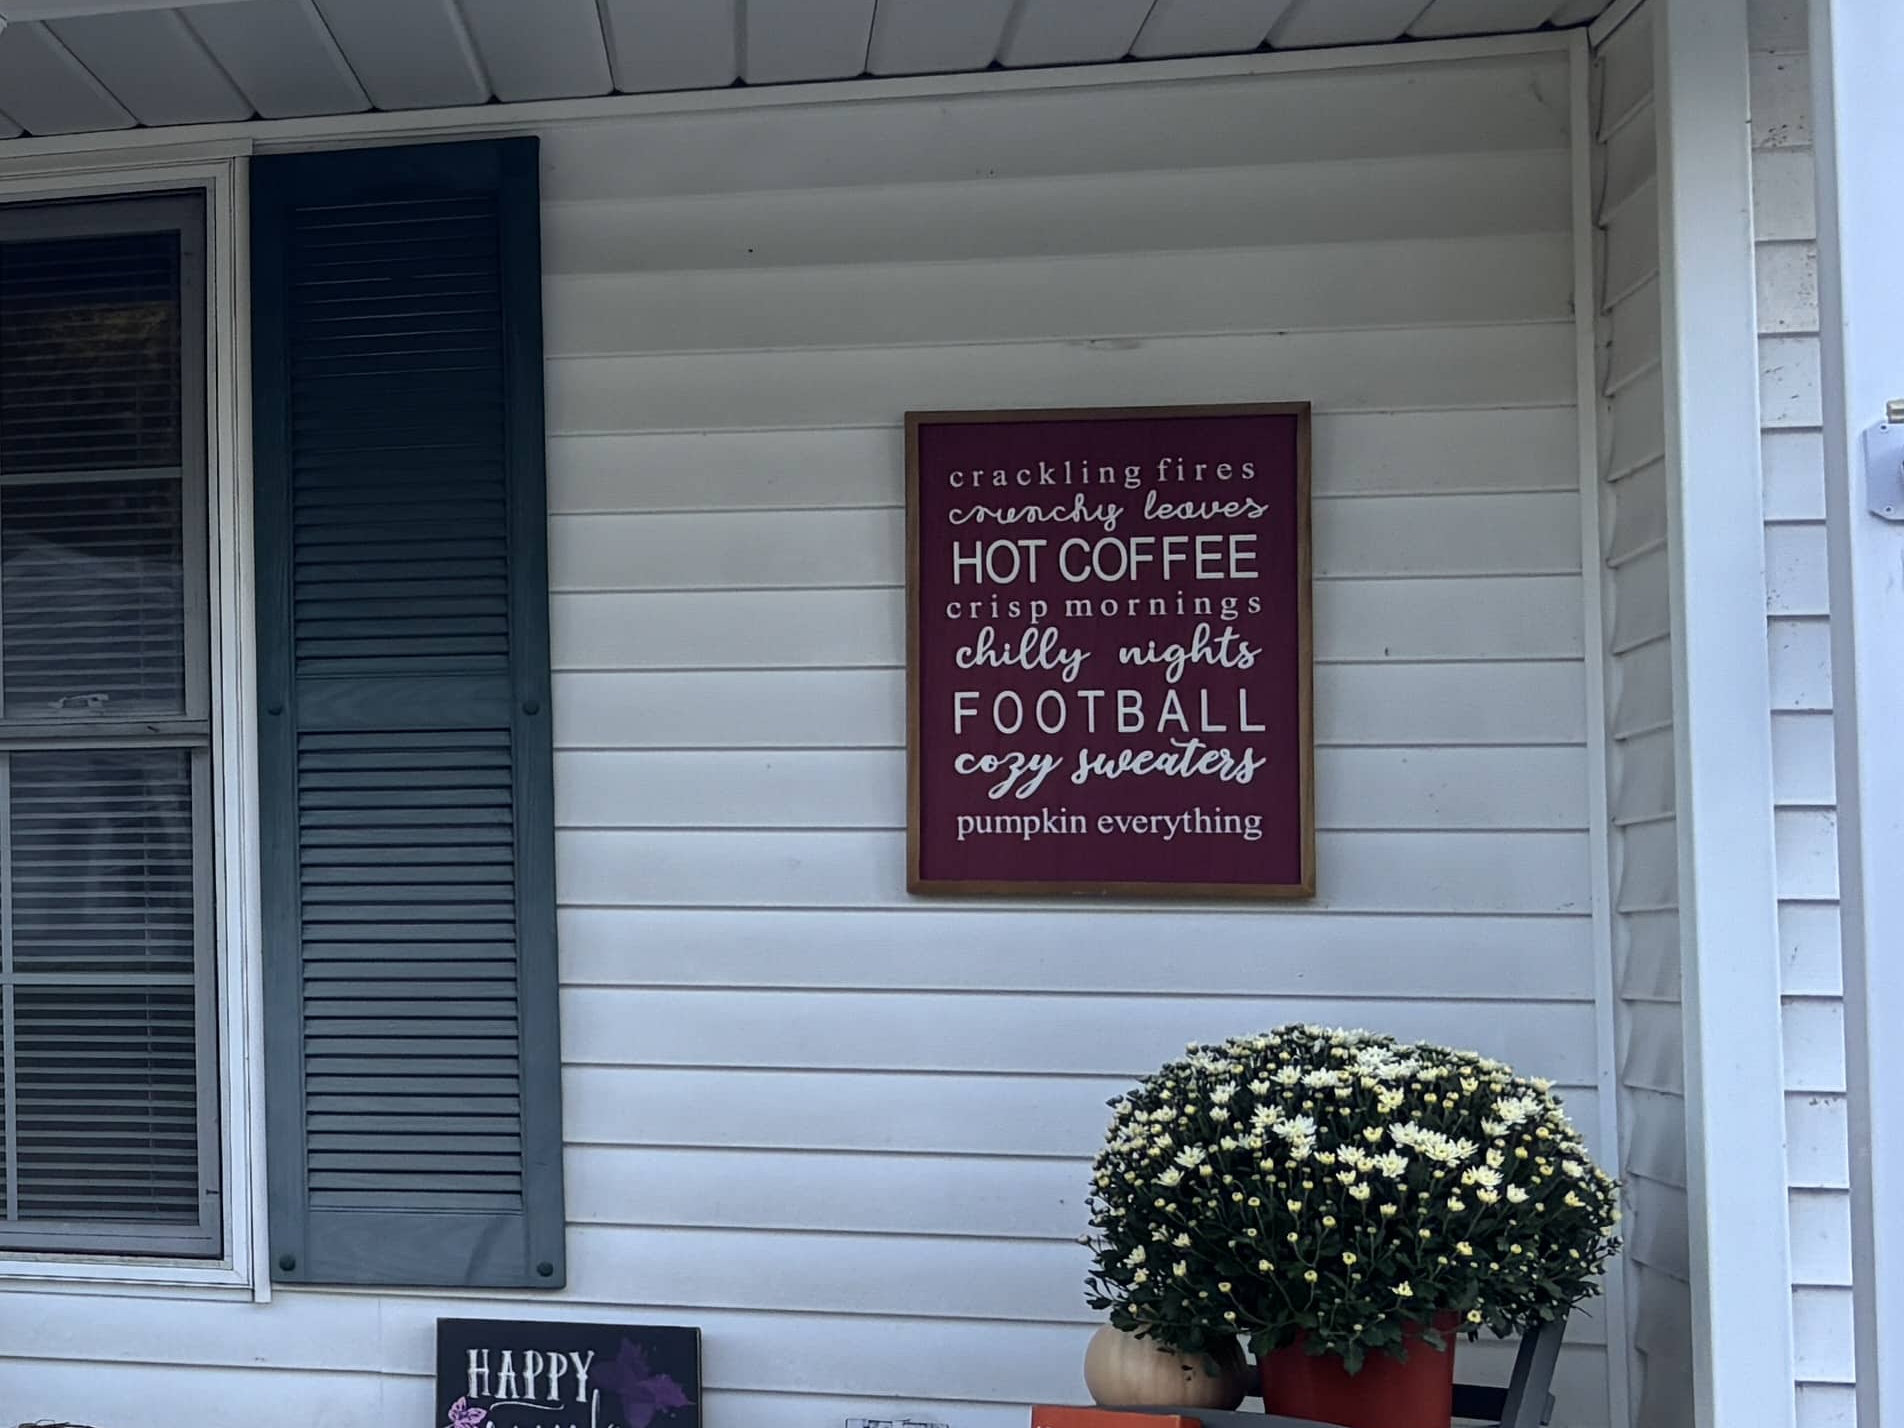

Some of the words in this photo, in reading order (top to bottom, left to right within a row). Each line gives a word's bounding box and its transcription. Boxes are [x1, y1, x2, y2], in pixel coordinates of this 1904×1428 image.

[949, 460, 1142, 489] crackling
[1157, 457, 1256, 482] fires
[948, 492, 1124, 532] crunchy
[1143, 490, 1269, 522] leaves
[952, 538, 1049, 585] HOT
[1058, 534, 1260, 585] COFFEE
[946, 593, 1049, 624] crisp
[1064, 589, 1262, 621] mornings
[955, 625, 1092, 683] chilly
[1118, 622, 1263, 684] nights
[953, 688, 1267, 735] FOOTBALL
[954, 751, 1062, 800] cozy
[1069, 737, 1266, 785] sweaters
[956, 806, 1088, 841] pumpkin
[1097, 806, 1263, 842] everything
[466, 1348, 594, 1403] HAPPY
